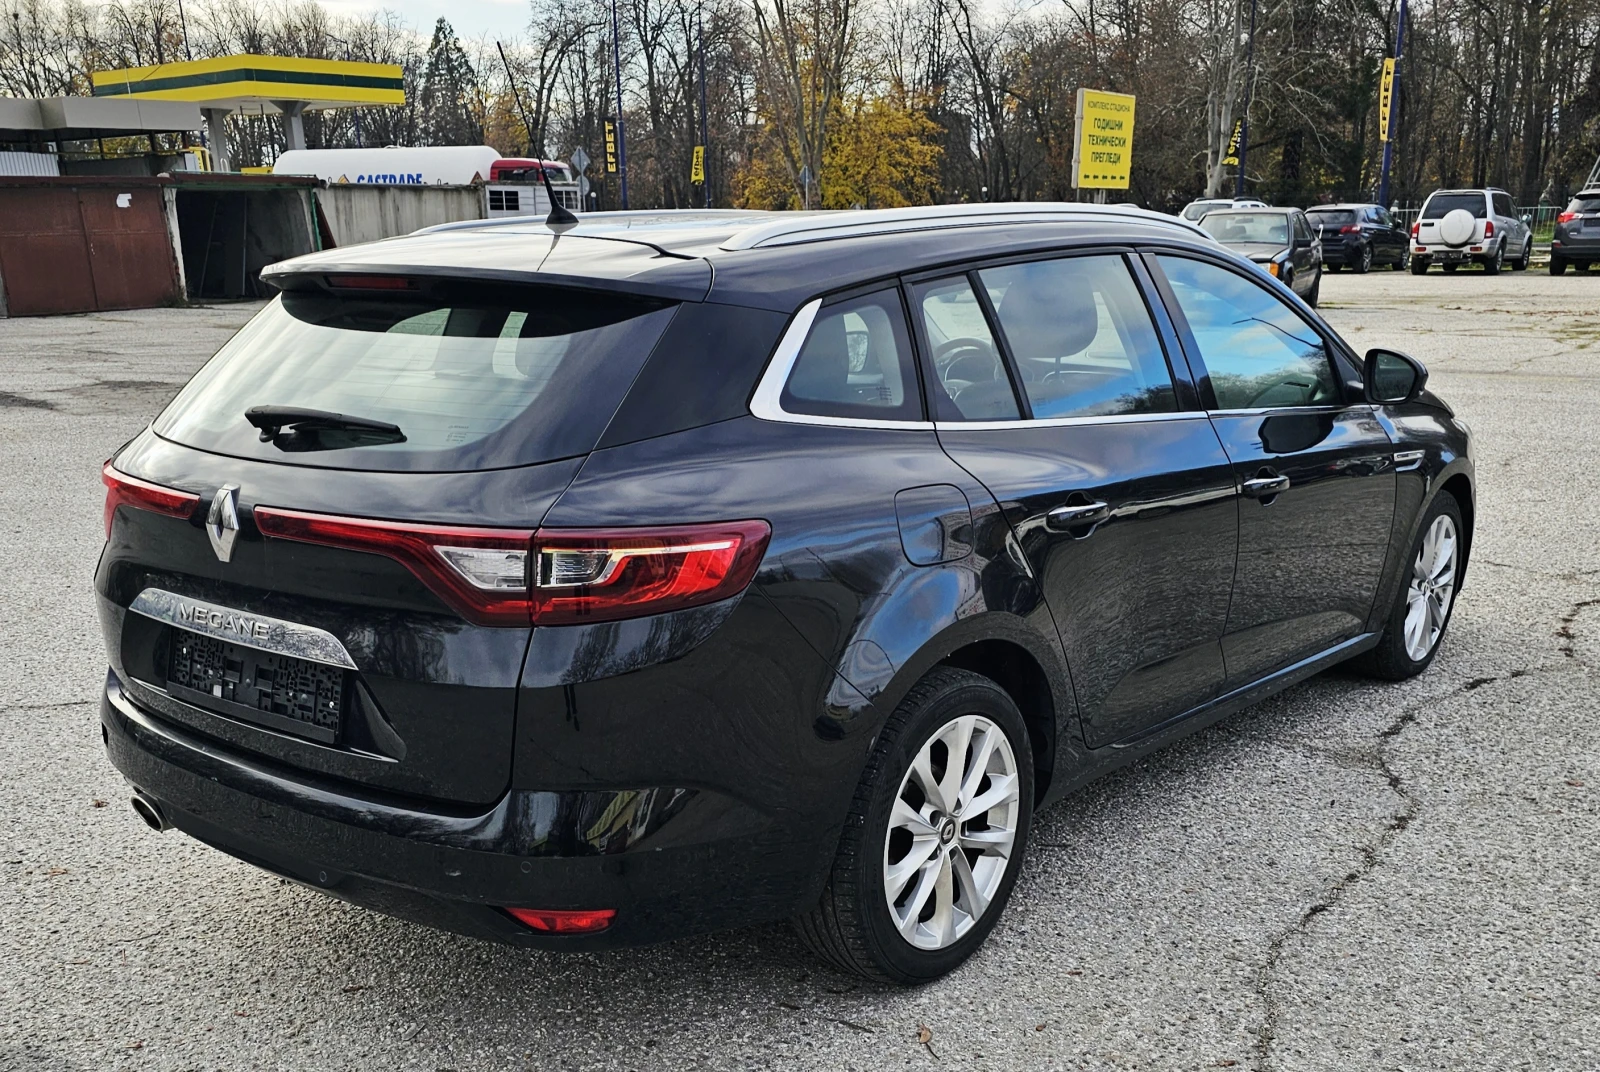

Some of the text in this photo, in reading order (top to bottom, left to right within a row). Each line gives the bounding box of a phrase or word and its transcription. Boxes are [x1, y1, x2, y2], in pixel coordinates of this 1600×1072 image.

[1087, 100, 1131, 113] КОМПЛЕКС СТАДИОНА
[1381, 64, 1392, 135] EFBET
[1093, 117, 1124, 132] ГОДИШНИ
[604, 120, 617, 173] EFBET
[1087, 134, 1127, 148] ТЕХНИЧЕСКИ
[1090, 151, 1122, 167] ПРЕГЛЕДИ
[180, 603, 271, 641] MEGANE
